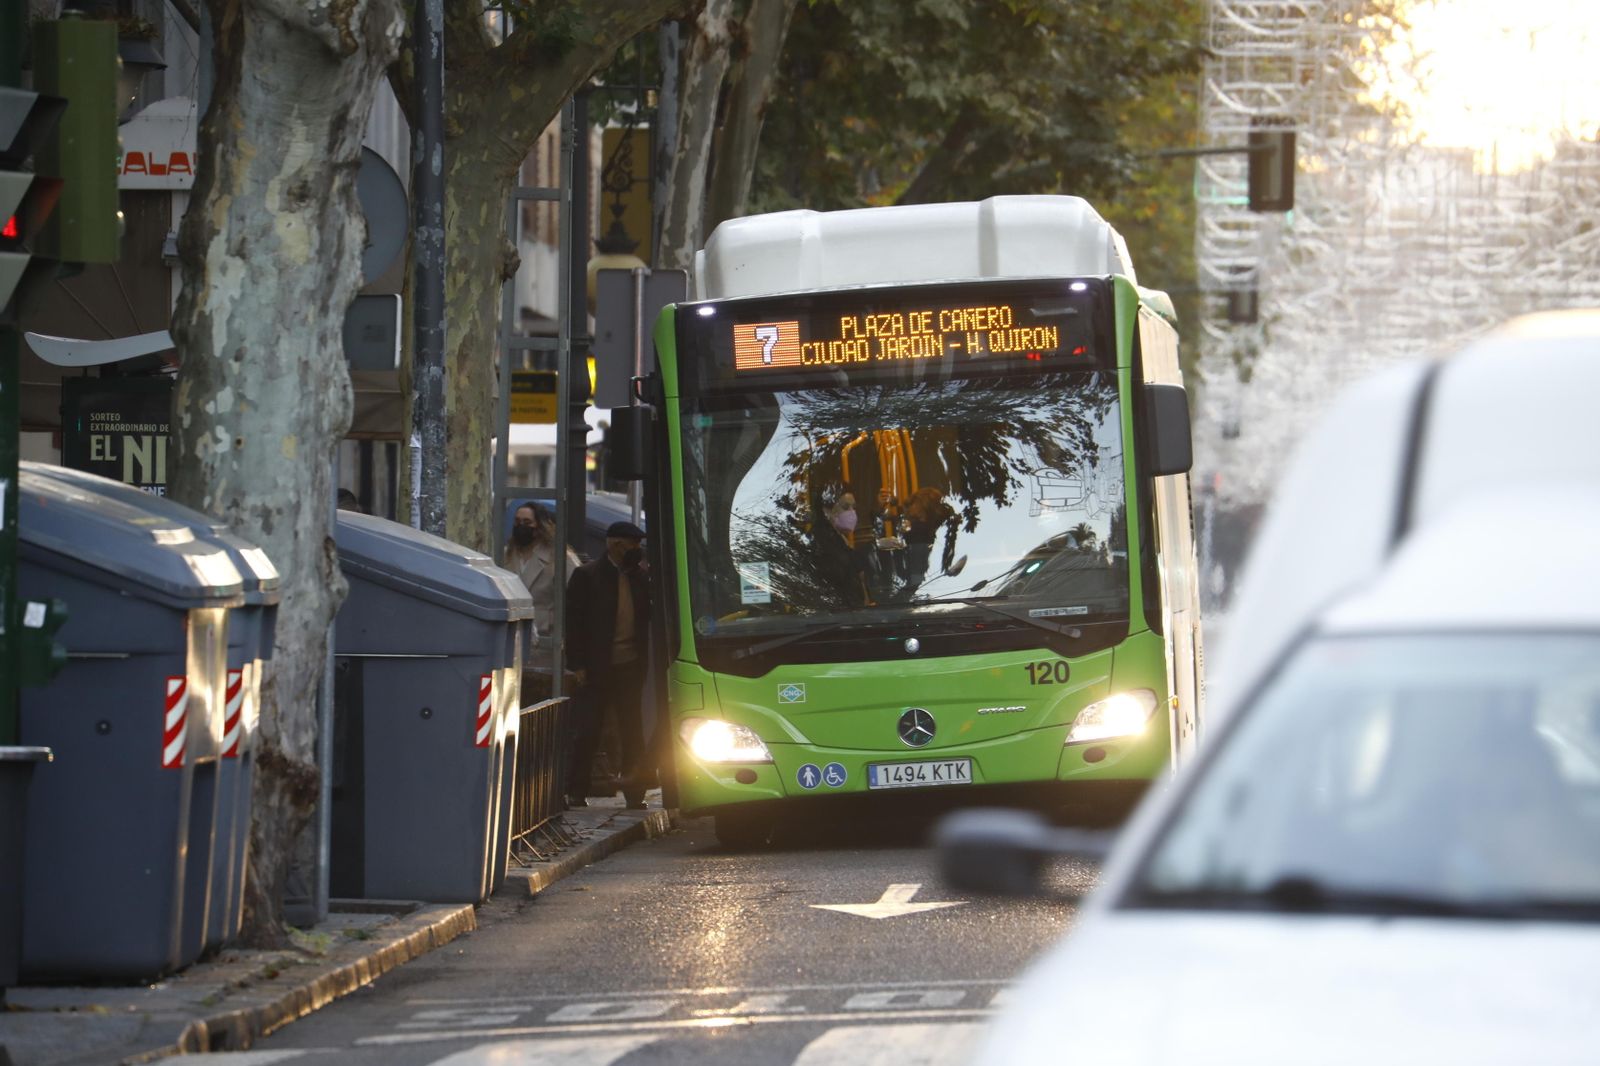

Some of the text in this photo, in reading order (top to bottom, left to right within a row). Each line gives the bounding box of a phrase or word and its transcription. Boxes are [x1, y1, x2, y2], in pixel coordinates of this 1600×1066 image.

[116, 151, 198, 175] ALA
[841, 306, 1012, 339] PLAZA DE CAÑERO
[755, 326, 778, 364] 7
[801, 340, 869, 365] CIUDAD
[876, 334, 944, 360] JARDIN
[967, 331, 984, 354] H.
[988, 326, 1058, 352] QUIRON
[90, 413, 121, 421] SORTEO
[90, 423, 169, 432] EXTRAORDINARIO DE
[90, 434, 173, 484] EL NI
[1024, 660, 1070, 685] 120
[883, 762, 966, 783] 1494 KTK
